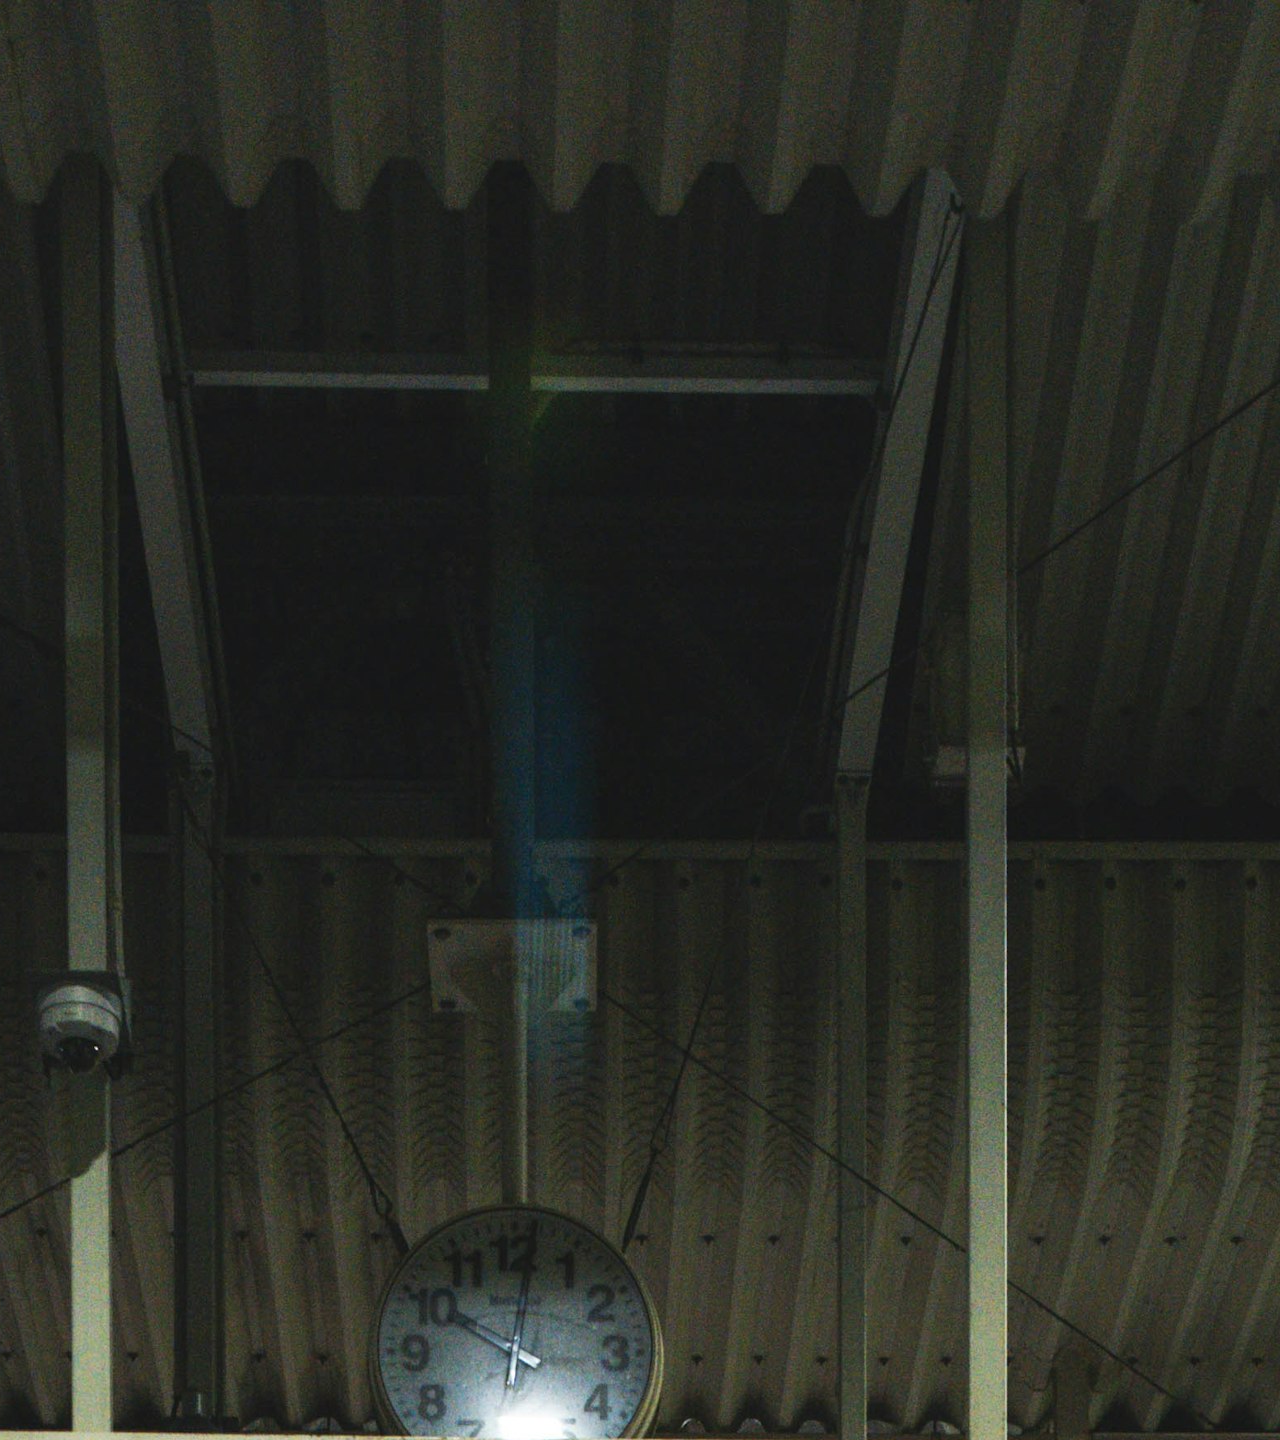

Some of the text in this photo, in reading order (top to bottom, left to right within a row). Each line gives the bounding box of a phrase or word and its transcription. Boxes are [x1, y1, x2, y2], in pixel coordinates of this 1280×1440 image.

[443, 1250, 483, 1287] 11
[556, 1251, 575, 1288] 1
[409, 1288, 457, 1326] 10
[587, 1284, 616, 1322] 2
[400, 1335, 430, 1372] 9
[601, 1335, 629, 1372] 3
[418, 1383, 447, 1421] 8
[584, 1383, 612, 1420] 4
